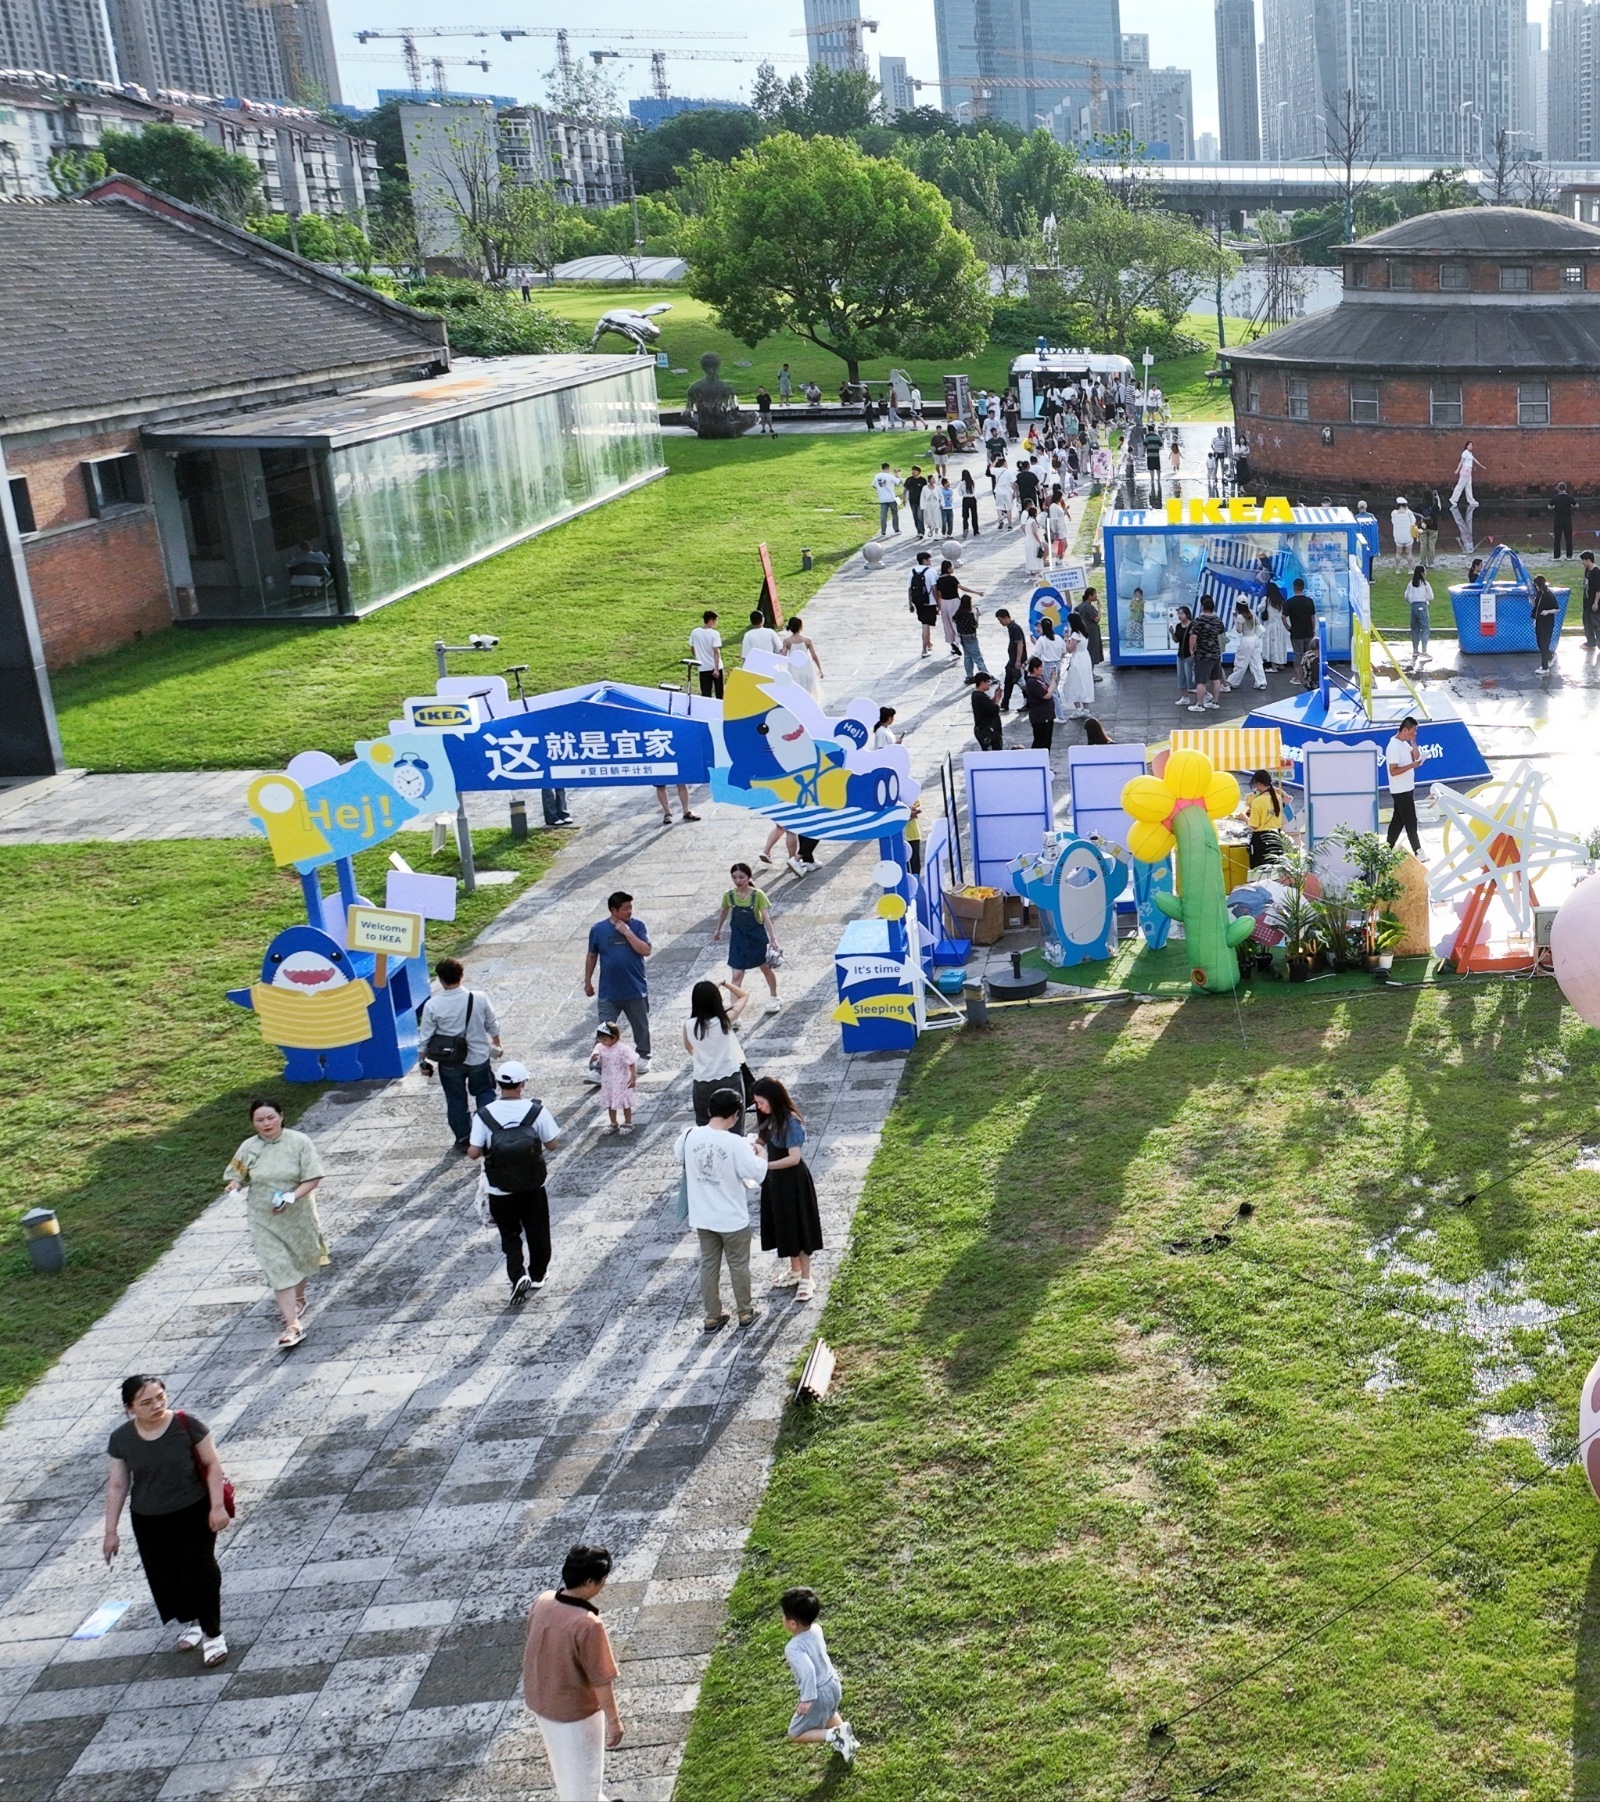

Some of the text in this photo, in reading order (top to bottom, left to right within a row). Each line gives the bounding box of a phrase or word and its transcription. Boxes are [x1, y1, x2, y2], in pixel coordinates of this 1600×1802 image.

[1166, 496, 1295, 524] IKEA
[418, 710, 467, 721] IKEA
[843, 722, 865, 739] Hej!
[484, 729, 678, 781] 这就是宜家
[580, 765, 653, 777] #夏日躺平计划
[299, 796, 394, 838] Hej!
[361, 920, 408, 934] Welcome
[365, 933, 402, 944] to IKEA
[854, 964, 901, 974] It's time
[853, 1003, 905, 1016] Sleeping
